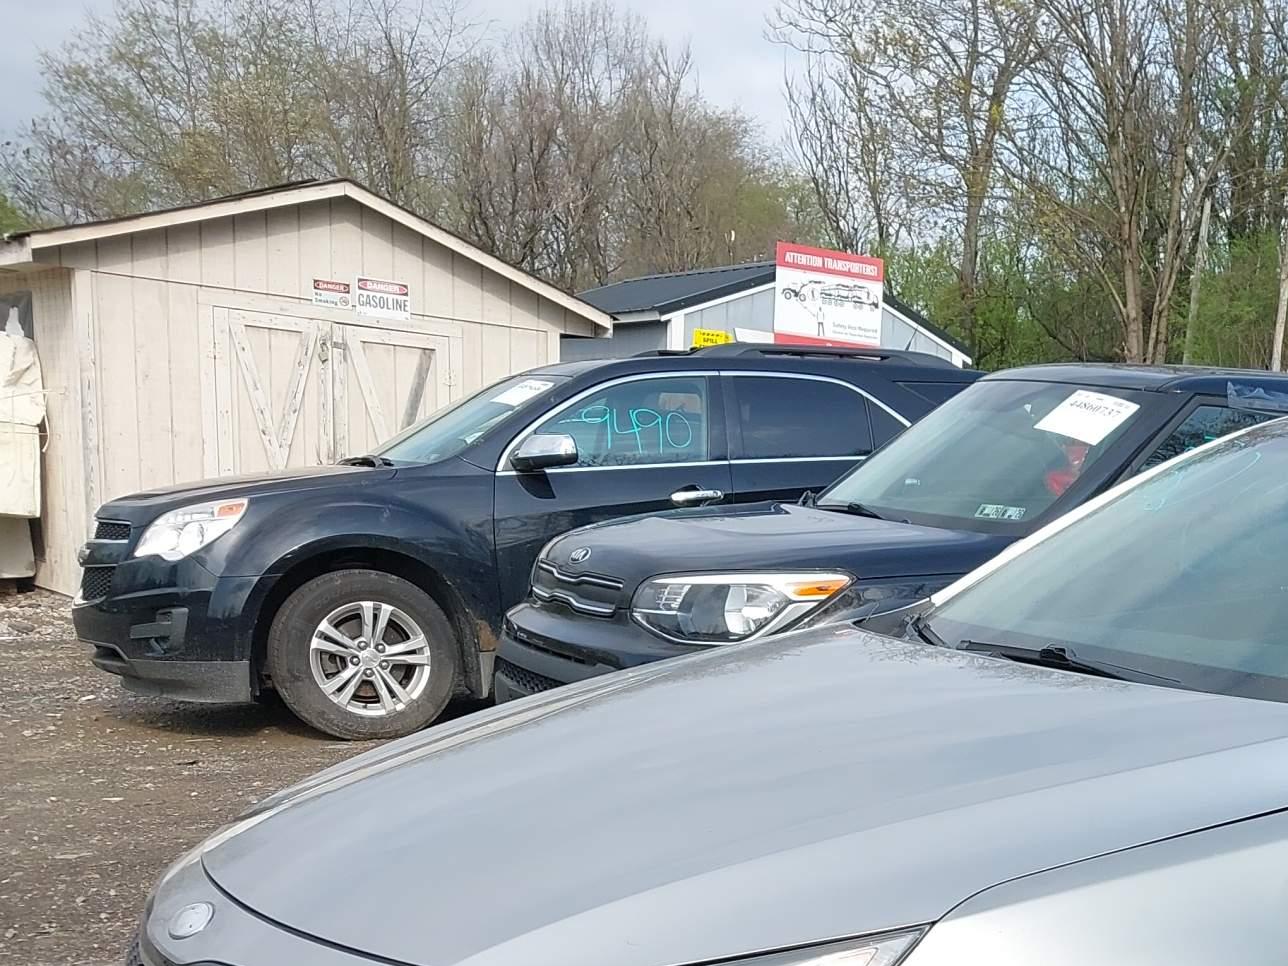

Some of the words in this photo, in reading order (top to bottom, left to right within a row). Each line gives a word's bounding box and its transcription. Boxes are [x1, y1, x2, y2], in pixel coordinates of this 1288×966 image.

[785, 251, 823, 268] ATTENTION
[823, 257, 878, 277] TRANSPORTERS!
[320, 282, 344, 290] DANGER
[366, 281, 400, 293] DANGER
[358, 293, 408, 312] GASOLINE
